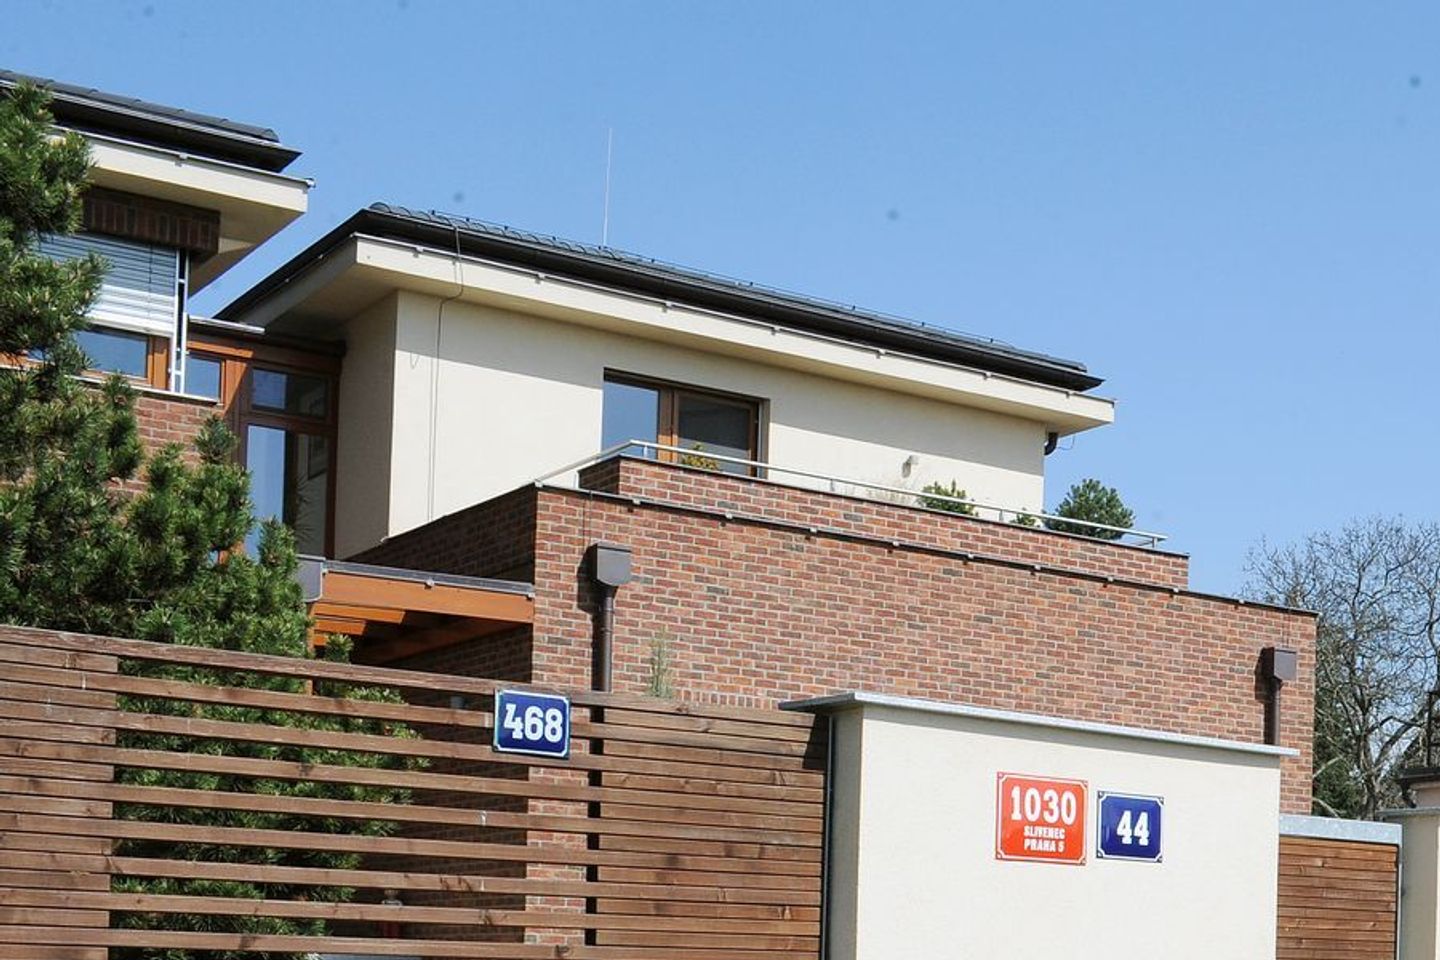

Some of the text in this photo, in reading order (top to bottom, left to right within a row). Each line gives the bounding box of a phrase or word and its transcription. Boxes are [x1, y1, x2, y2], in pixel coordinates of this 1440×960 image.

[503, 702, 563, 743] 468
[1010, 785, 1077, 826] 1030
[1023, 838, 1066, 853] PRAHA 5
[1116, 809, 1150, 846] 44
